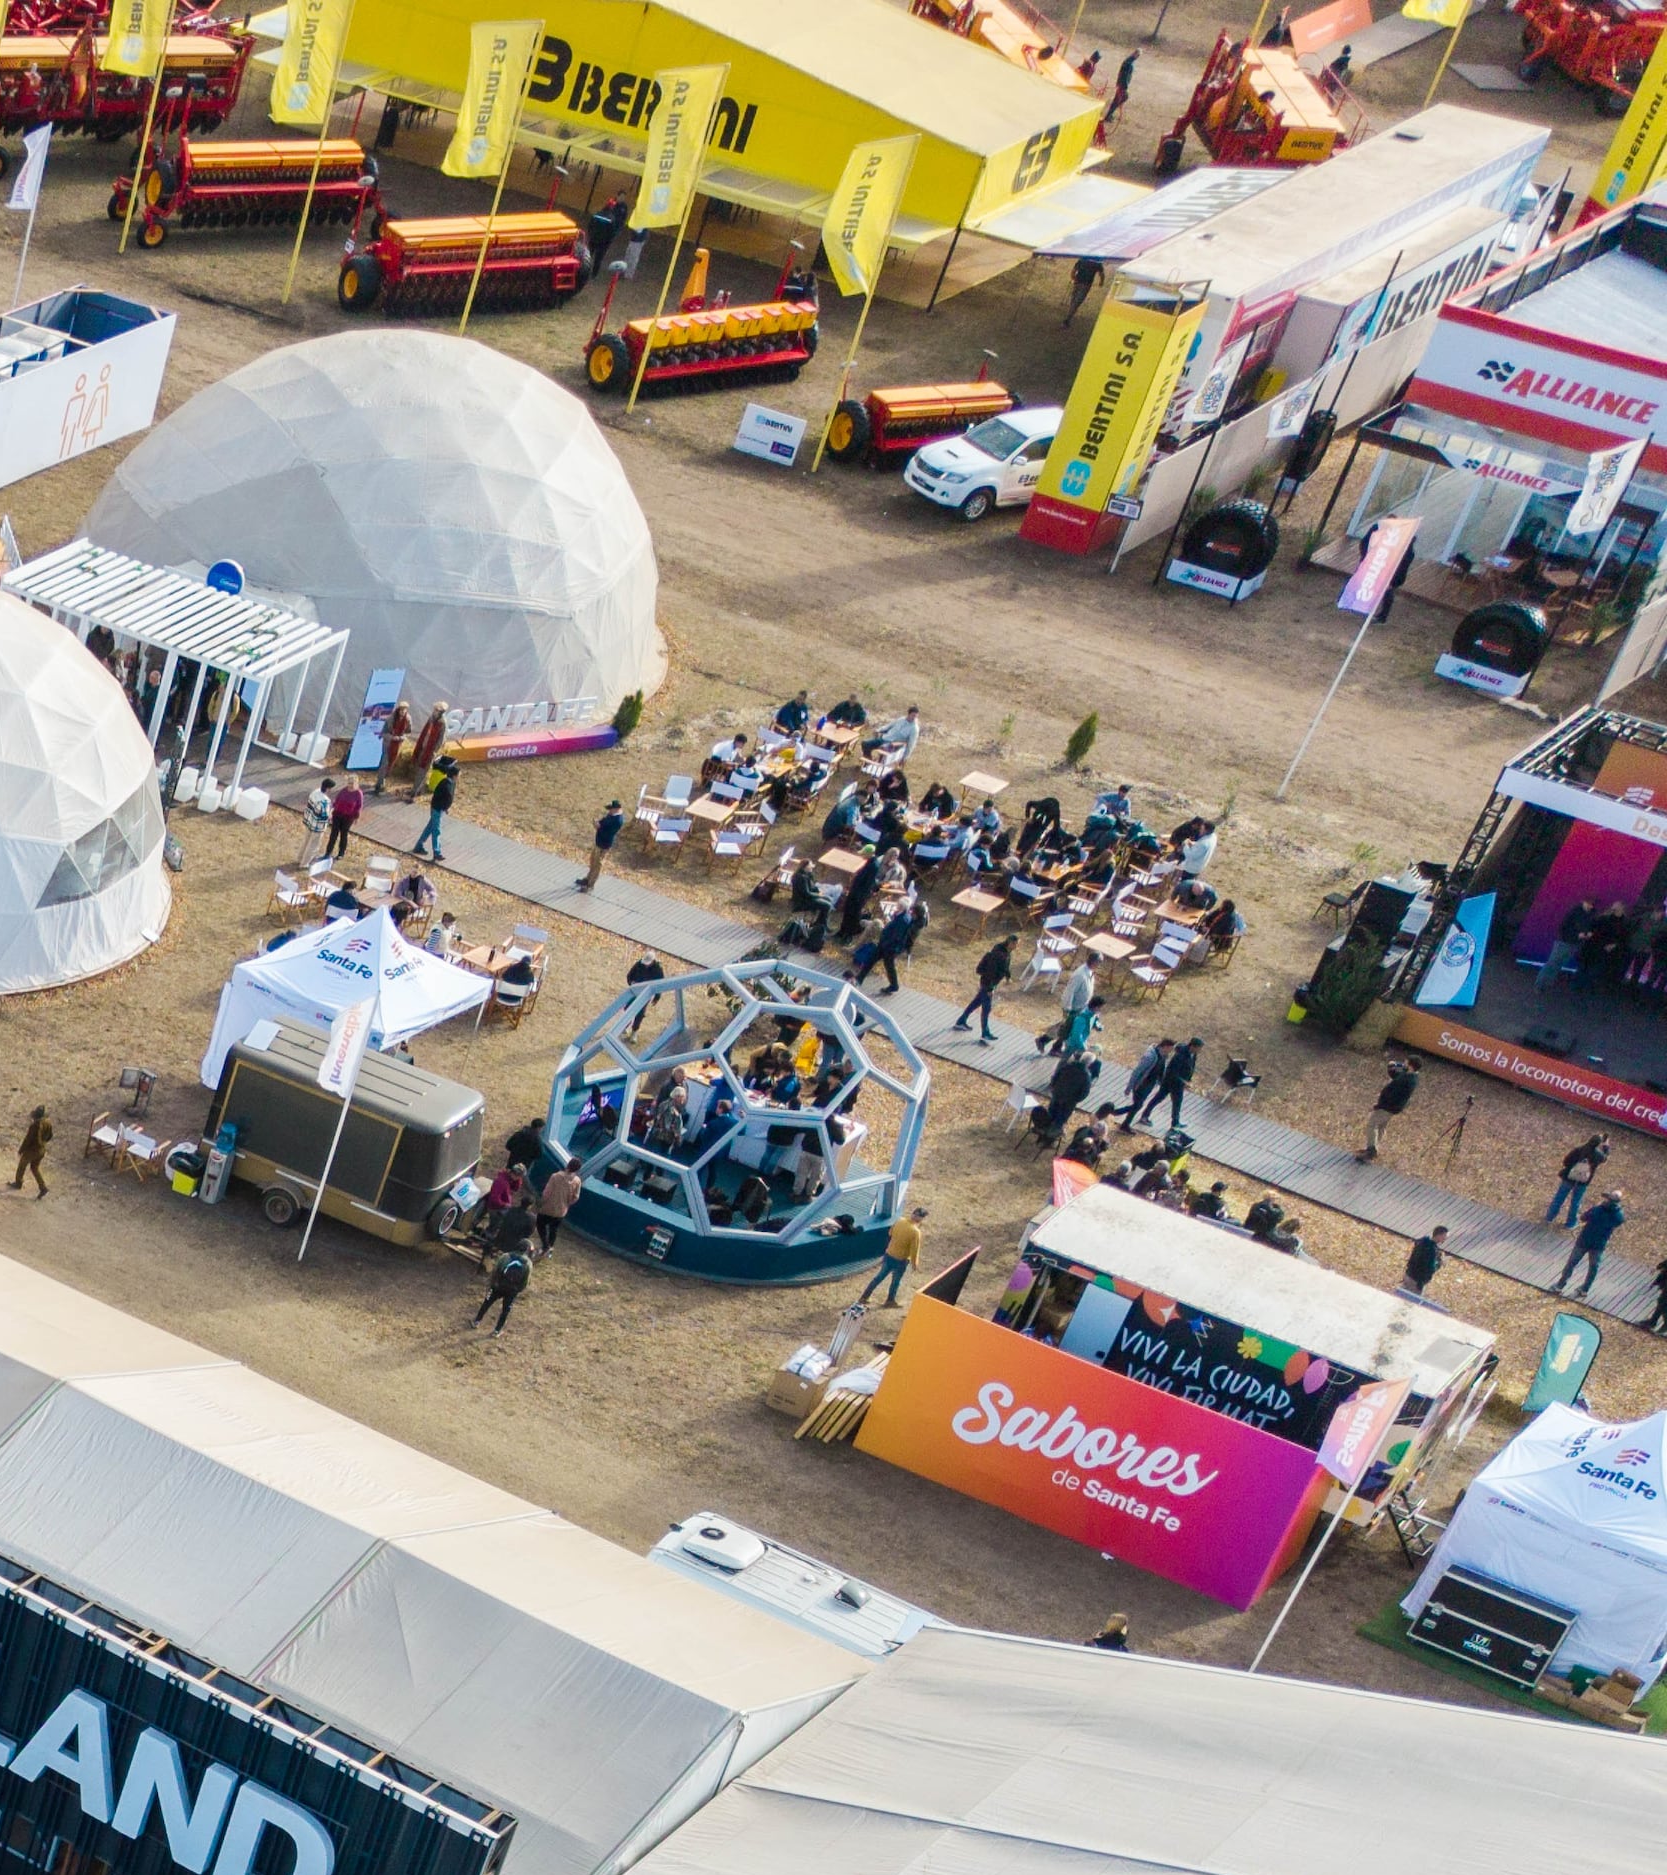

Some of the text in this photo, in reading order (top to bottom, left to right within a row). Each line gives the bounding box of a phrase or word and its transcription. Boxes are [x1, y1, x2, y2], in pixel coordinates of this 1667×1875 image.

[568, 62, 758, 153] BERNI
[1080, 329, 1144, 462] BERTINI S.A.
[1506, 366, 1659, 425] ALLIANCE
[1475, 463, 1553, 492] ALLIANCE
[445, 696, 598, 734] SANTA FE
[487, 743, 538, 758] Conecta
[317, 948, 374, 980] Santa Fe
[1438, 1031, 1489, 1059] Somos
[1492, 1047, 1508, 1067] la
[1510, 1053, 1601, 1100] locomotora
[1605, 1093, 1634, 1111] del
[1121, 1328, 1296, 1419] VIVI LA CIUDAD,
[951, 1382, 1218, 1496] Sabores
[1052, 1467, 1181, 1532] de Santa Fe
[1576, 1461, 1658, 1501] Santa Fe
